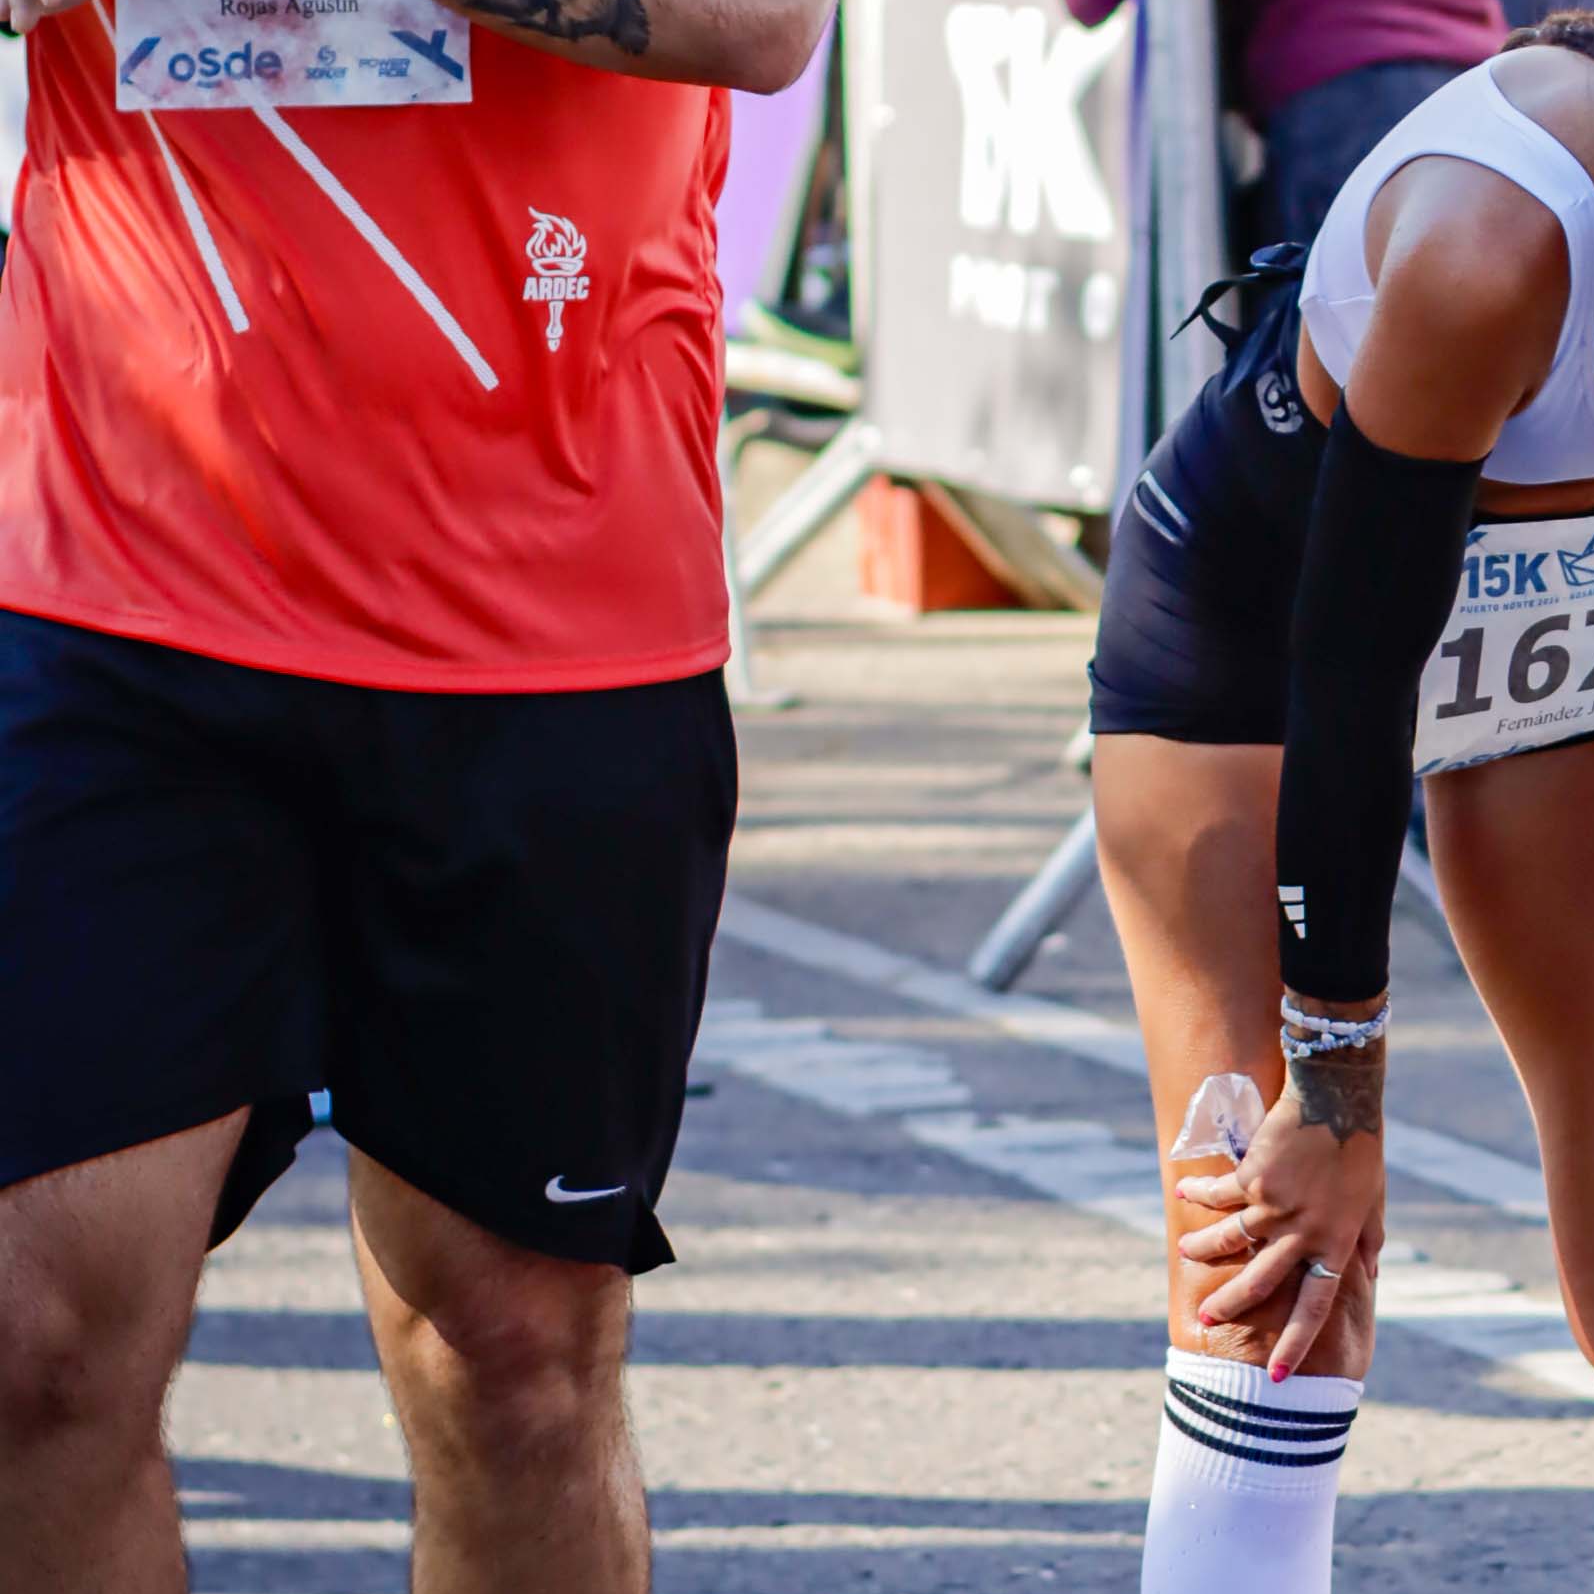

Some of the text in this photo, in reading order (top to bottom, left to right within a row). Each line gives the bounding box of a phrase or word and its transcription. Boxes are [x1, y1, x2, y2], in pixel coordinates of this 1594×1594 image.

[168, 41, 283, 89] osde
[522, 276, 591, 302] ARDEC
[1462, 552, 1550, 599] 15K
[1460, 603, 1499, 614] PUERTO
[1503, 599, 1535, 611] NORTE
[1496, 706, 1584, 735] Fernández
